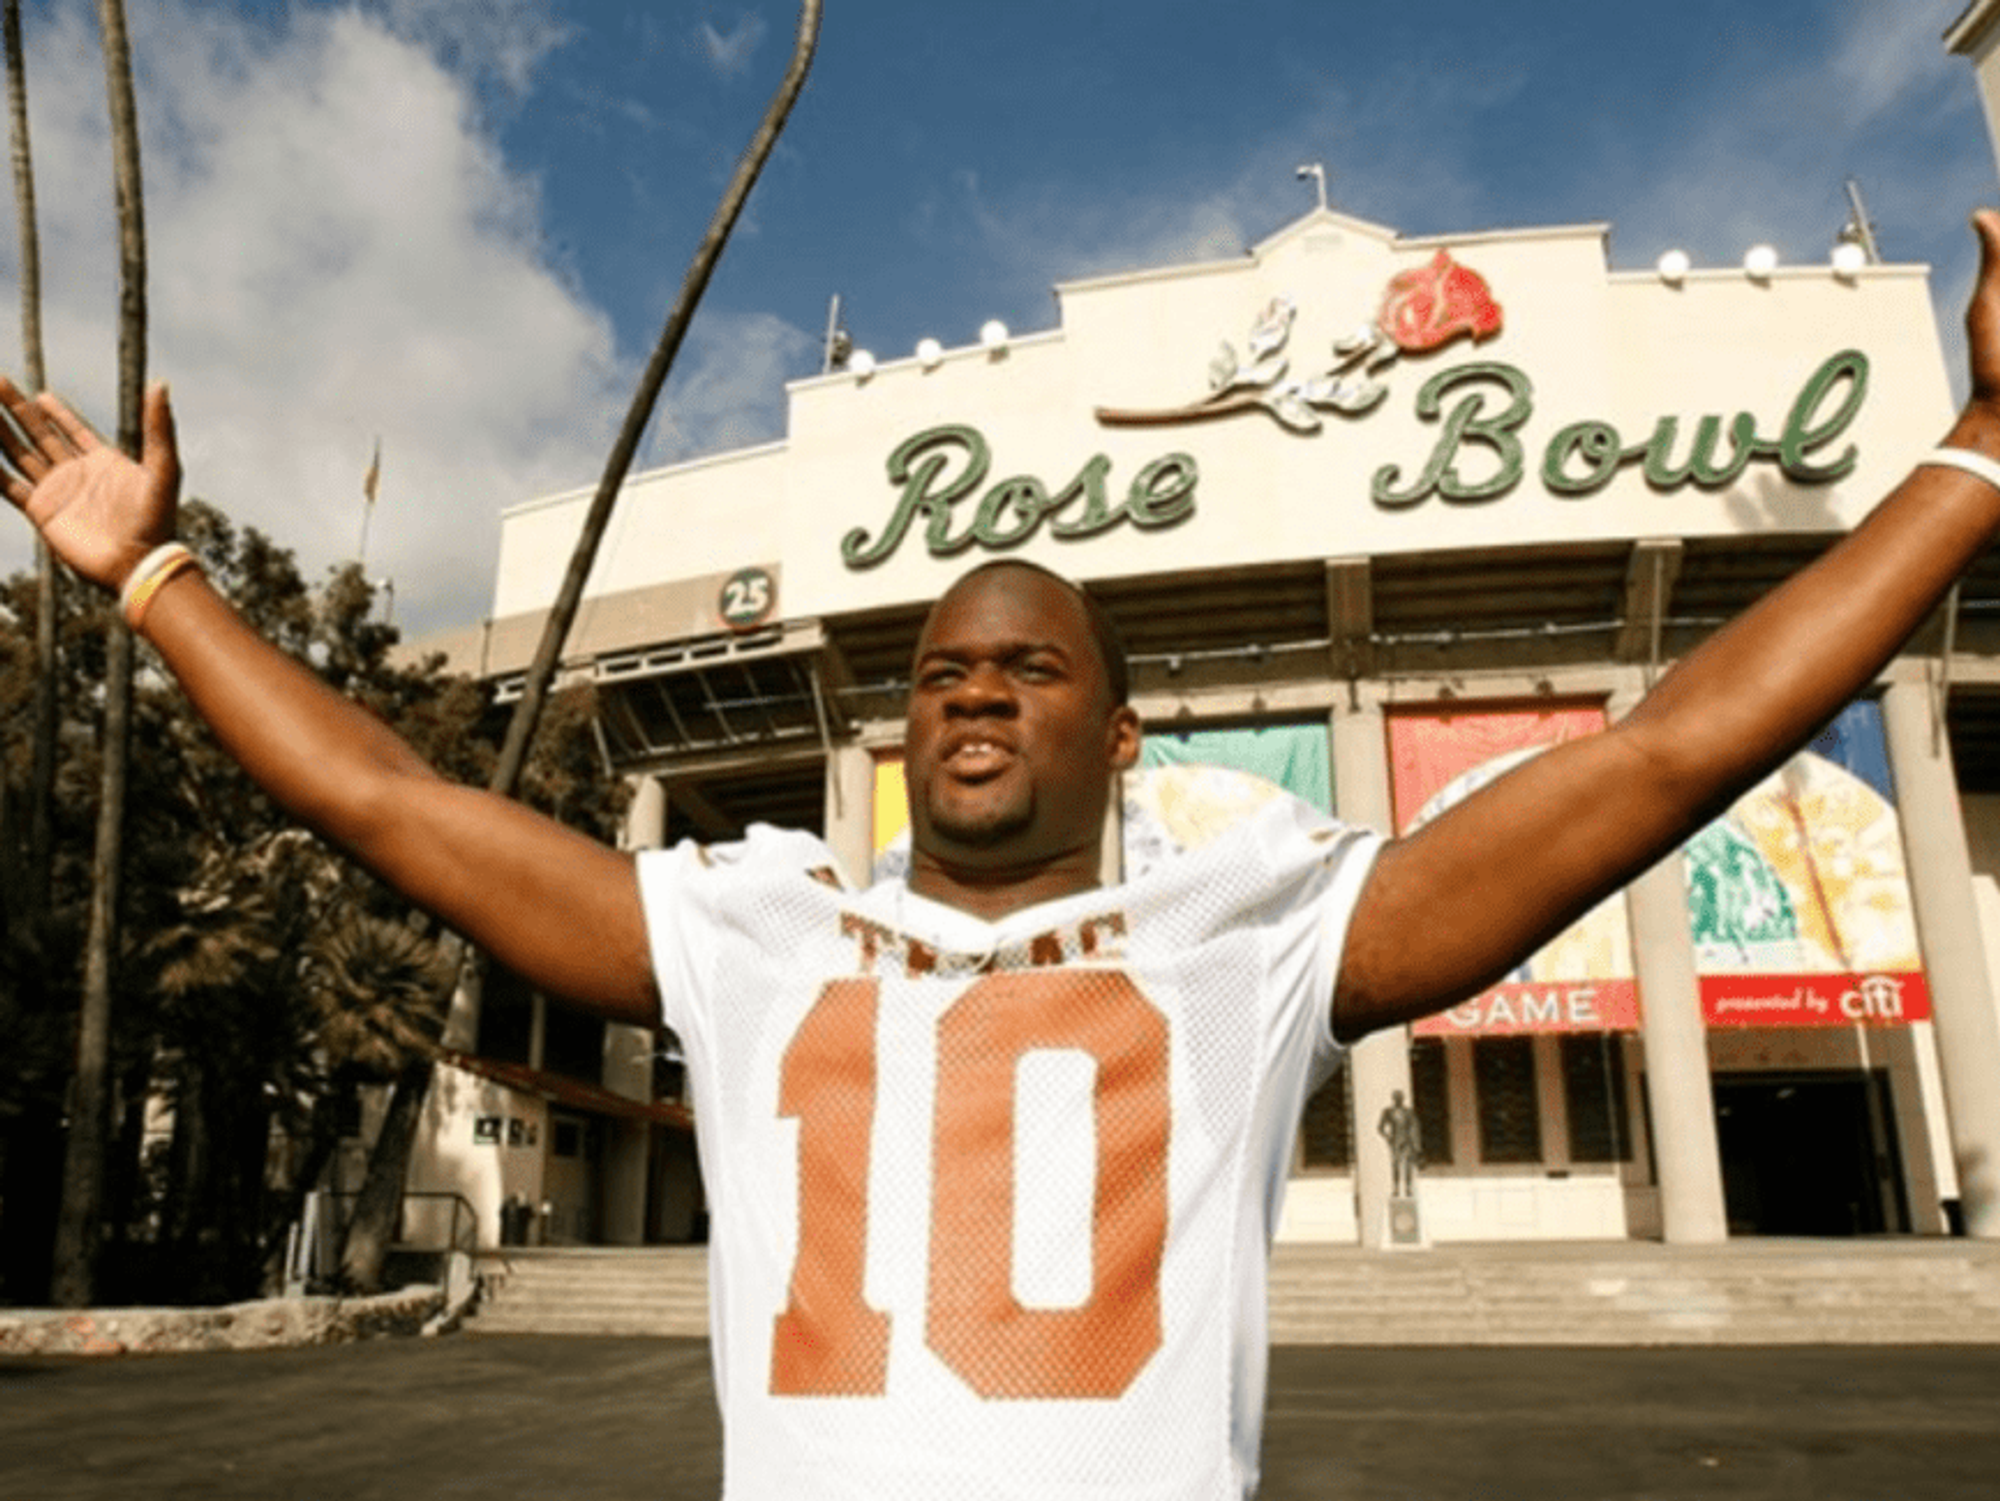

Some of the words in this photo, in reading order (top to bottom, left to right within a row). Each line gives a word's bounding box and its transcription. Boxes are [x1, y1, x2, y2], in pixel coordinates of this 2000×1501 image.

[841, 423, 1199, 571] Rose
[1371, 348, 1870, 511] Bowl
[726, 577, 768, 616] 25
[1446, 988, 1600, 1028] GAME
[1839, 975, 1905, 1018] citi
[768, 968, 1171, 1400] 10
